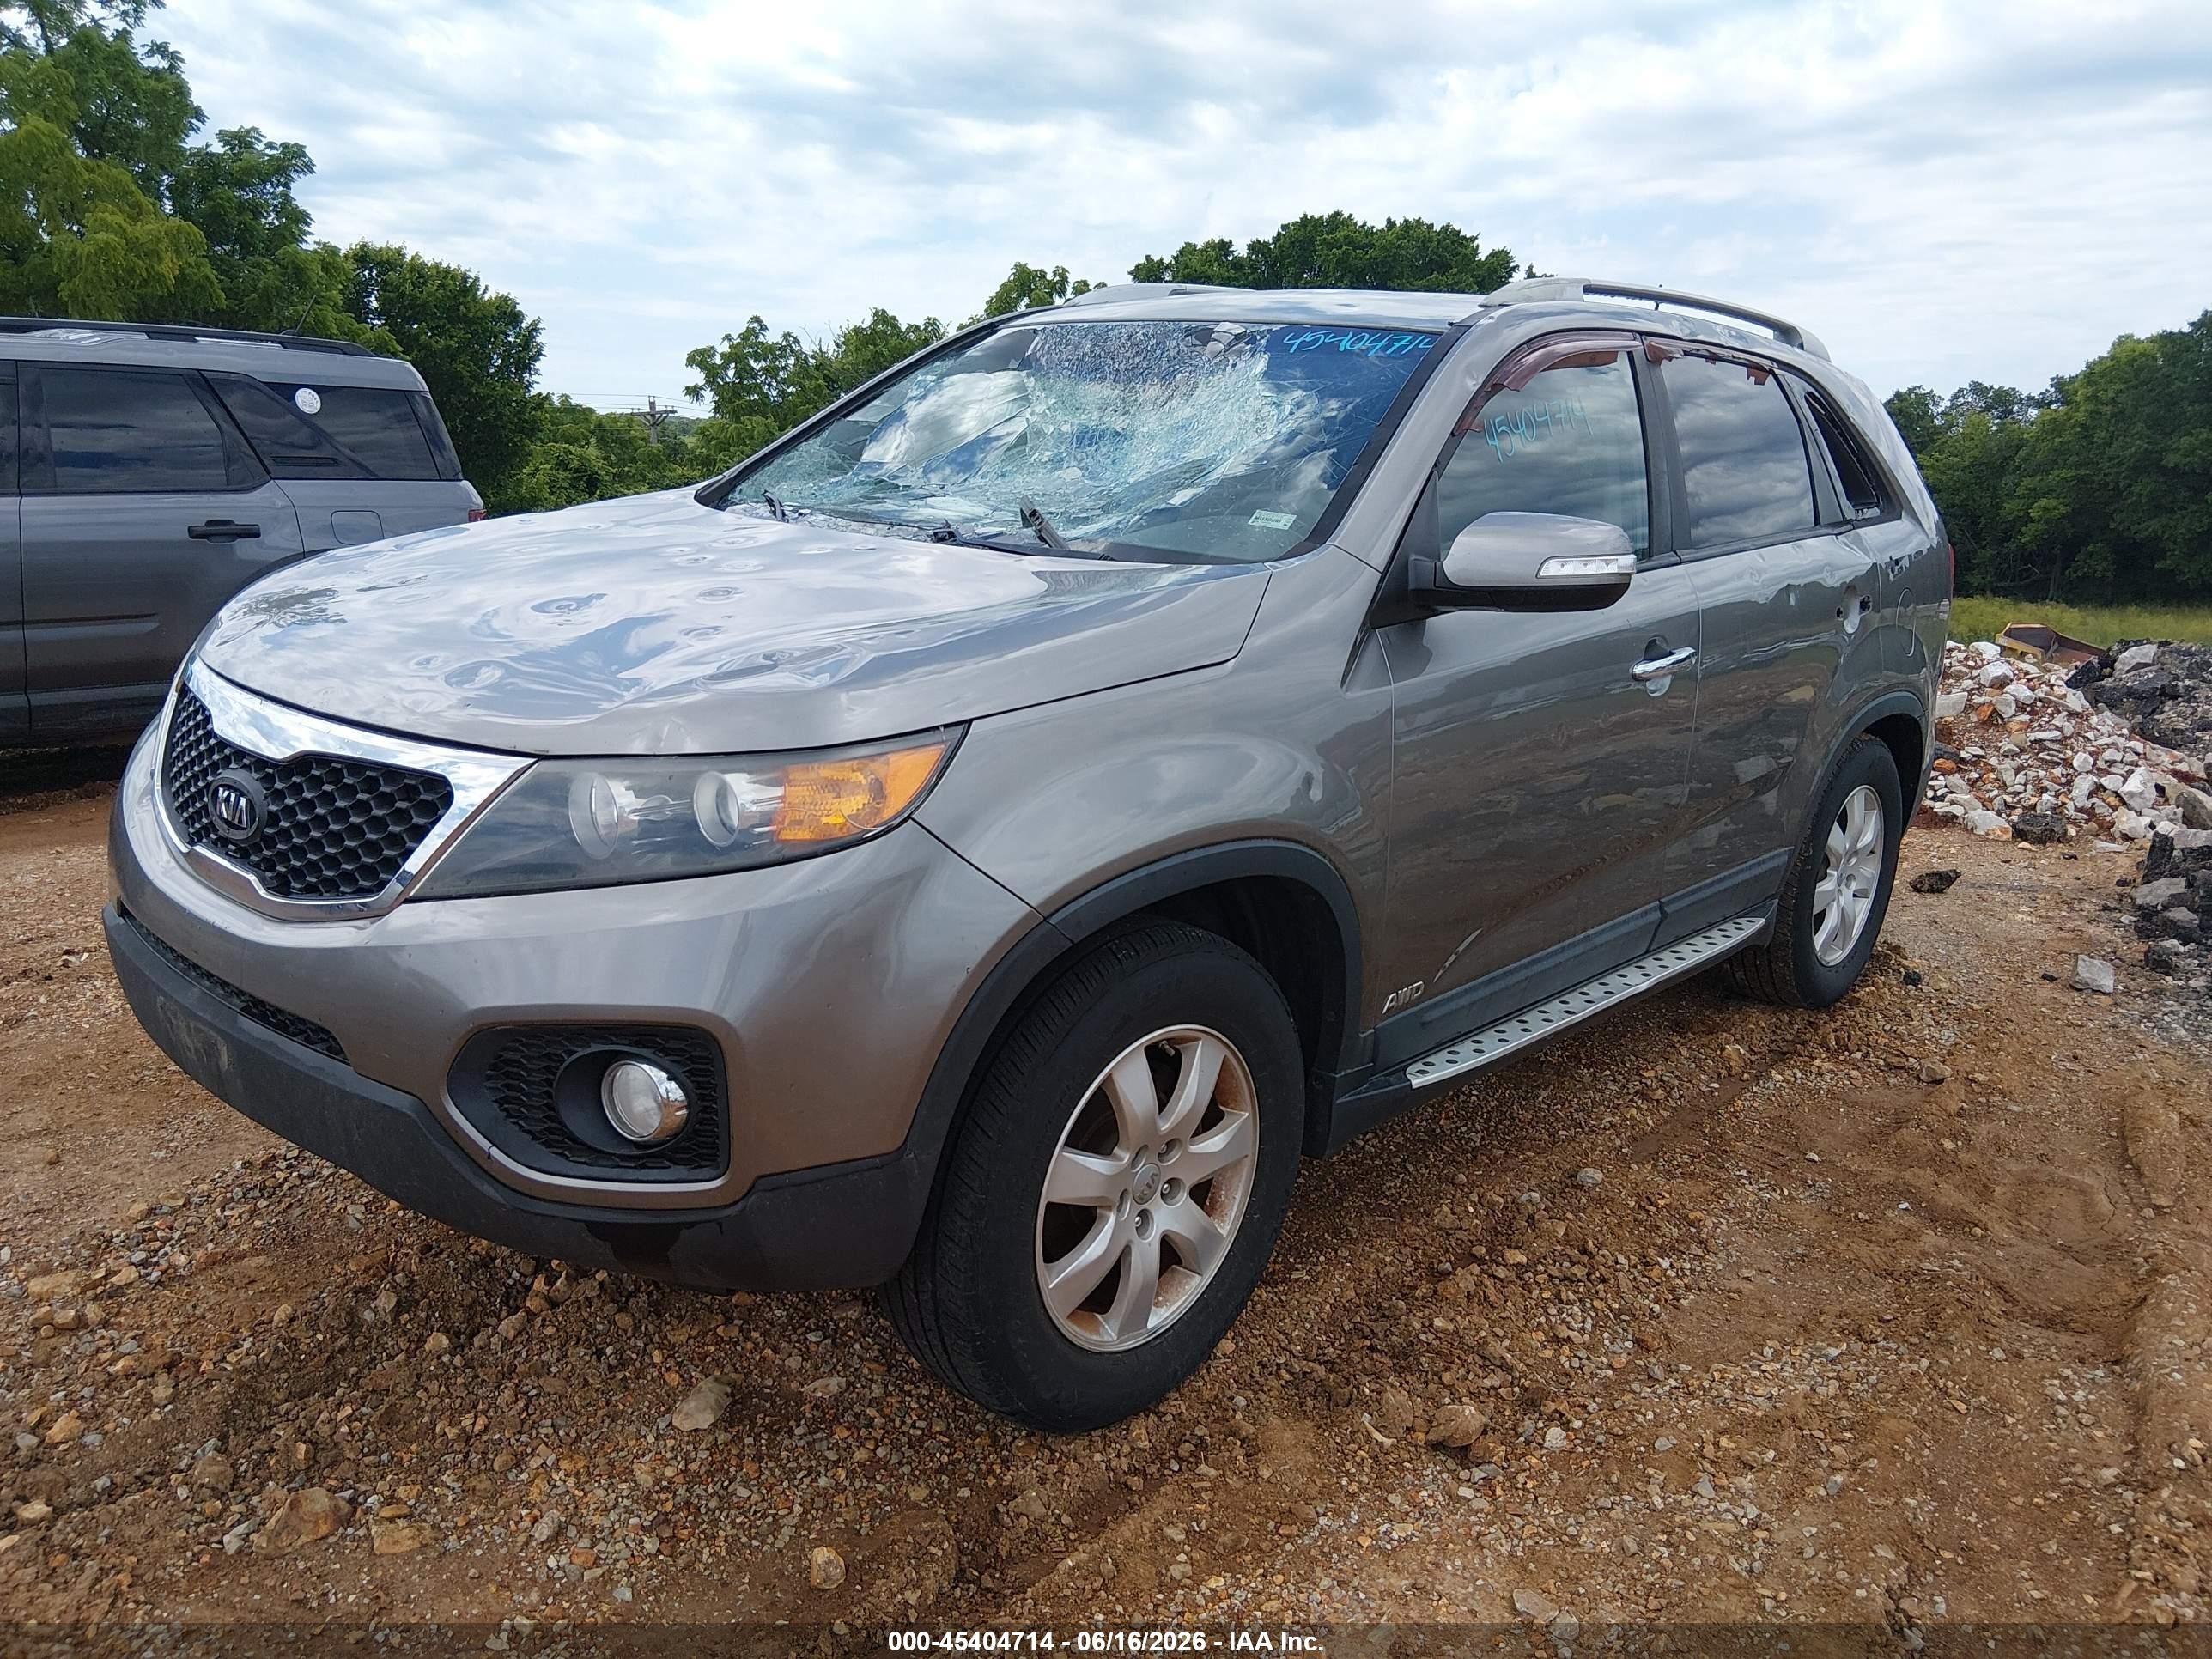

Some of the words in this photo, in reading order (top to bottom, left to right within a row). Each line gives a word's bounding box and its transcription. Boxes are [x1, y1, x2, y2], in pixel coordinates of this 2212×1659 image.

[1483, 397, 1594, 464] 45404714
[216, 786, 248, 829] KIA
[1382, 981, 1425, 1014] AWD
